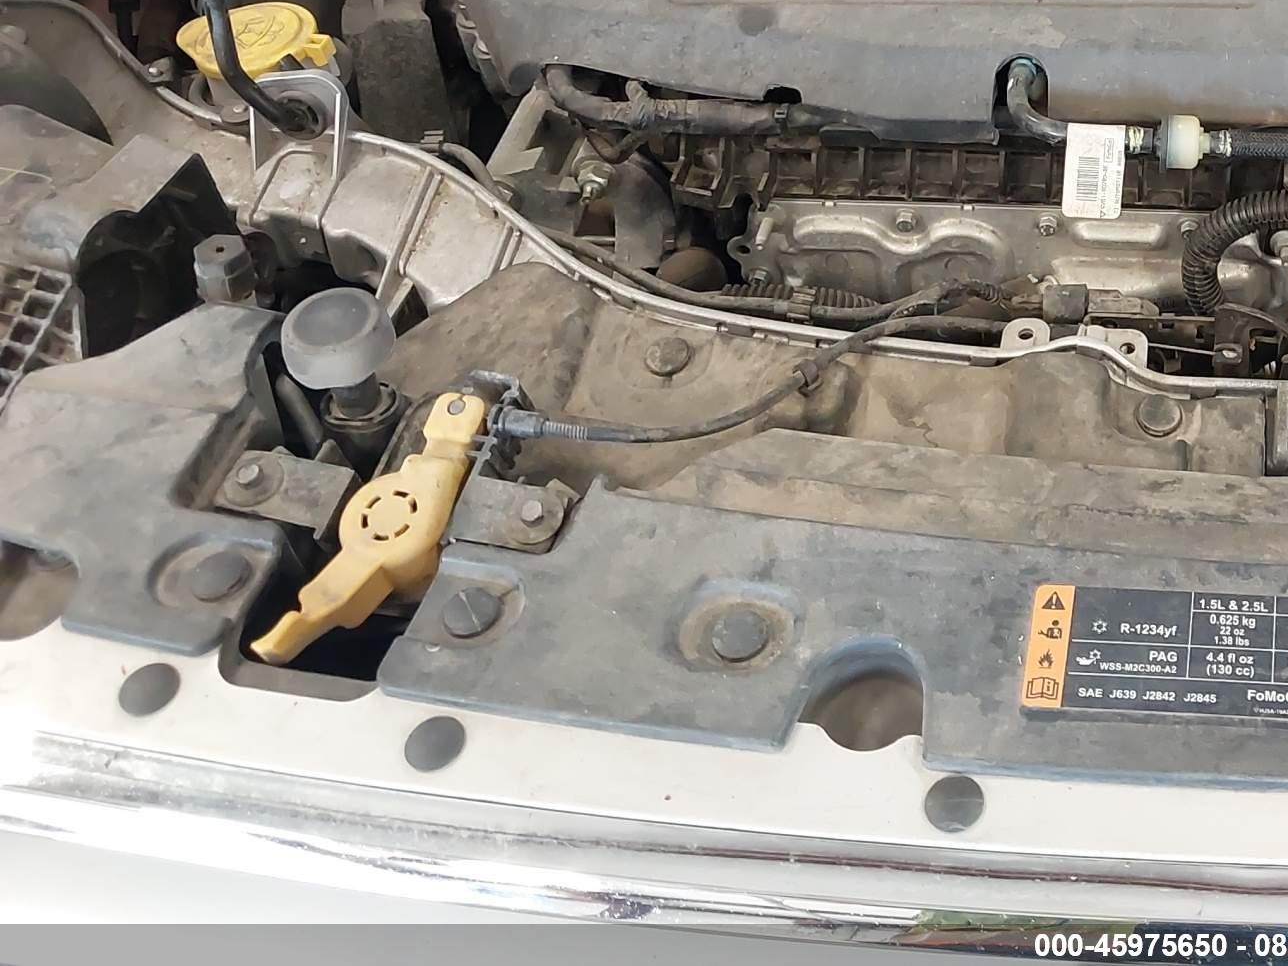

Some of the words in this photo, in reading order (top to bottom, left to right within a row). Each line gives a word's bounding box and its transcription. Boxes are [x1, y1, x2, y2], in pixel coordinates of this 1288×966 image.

[1200, 598, 1225, 610] 1.5L
[1228, 600, 1238, 610] &
[1241, 601, 1269, 612] 2.5L
[1210, 614, 1240, 626] 0.625
[1242, 616, 1256, 629] kg
[1120, 622, 1178, 638] R-1234yf
[1220, 626, 1231, 636] 22
[1233, 628, 1245, 636] oz
[1214, 636, 1233, 645] 1.38
[1235, 637, 1250, 646] lbs
[1148, 650, 1178, 662] PAG
[1206, 652, 1224, 663] 4.4
[1227, 653, 1236, 664] fl
[1238, 656, 1254, 664] oz
[1100, 662, 1177, 674] WSS-M2C300-A2
[1206, 664, 1232, 676] (130
[1235, 666, 1255, 678] cc)
[1078, 688, 1104, 698] SAE
[1109, 690, 1137, 700] J639
[1142, 691, 1176, 702] J2842
[1183, 693, 1217, 704] J2845
